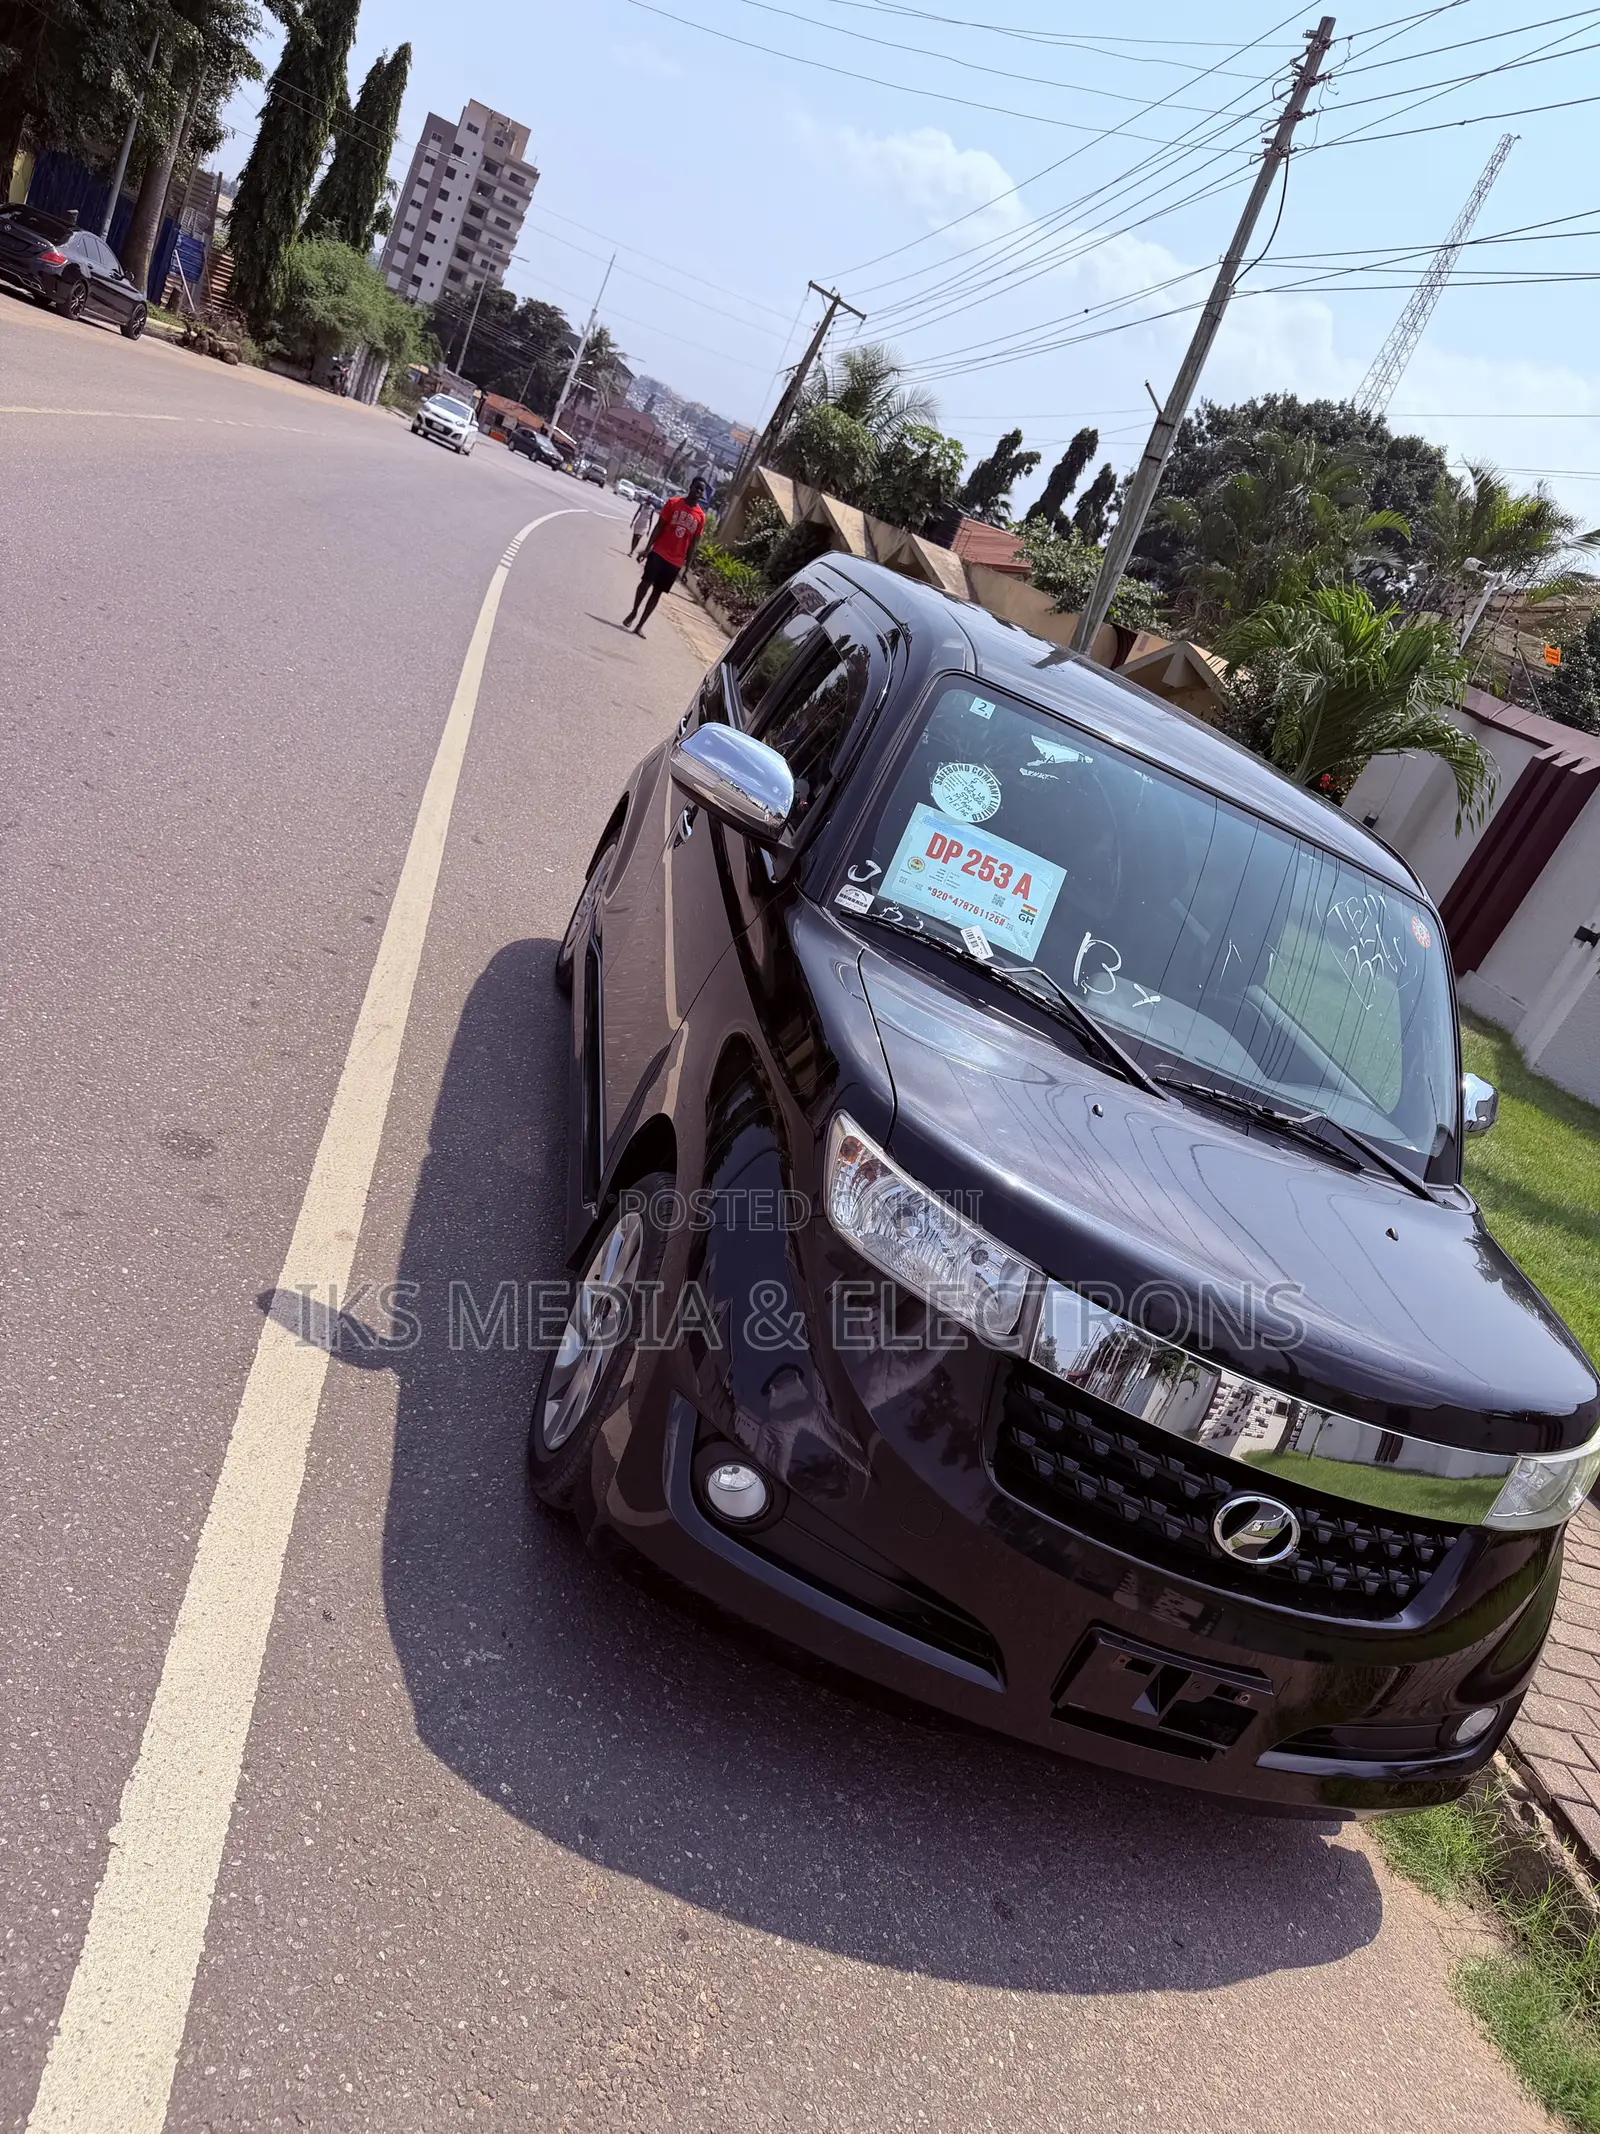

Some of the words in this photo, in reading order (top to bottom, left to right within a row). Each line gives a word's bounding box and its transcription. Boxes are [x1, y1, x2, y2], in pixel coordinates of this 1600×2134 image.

[934, 764, 970, 786] SAFEBOND
[971, 766, 1000, 799] COMPANY
[971, 800, 999, 822] LIMITED
[925, 831, 964, 865] DP
[960, 848, 1014, 890] 253
[1011, 872, 1032, 901] A
[1018, 912, 1035, 926] GH
